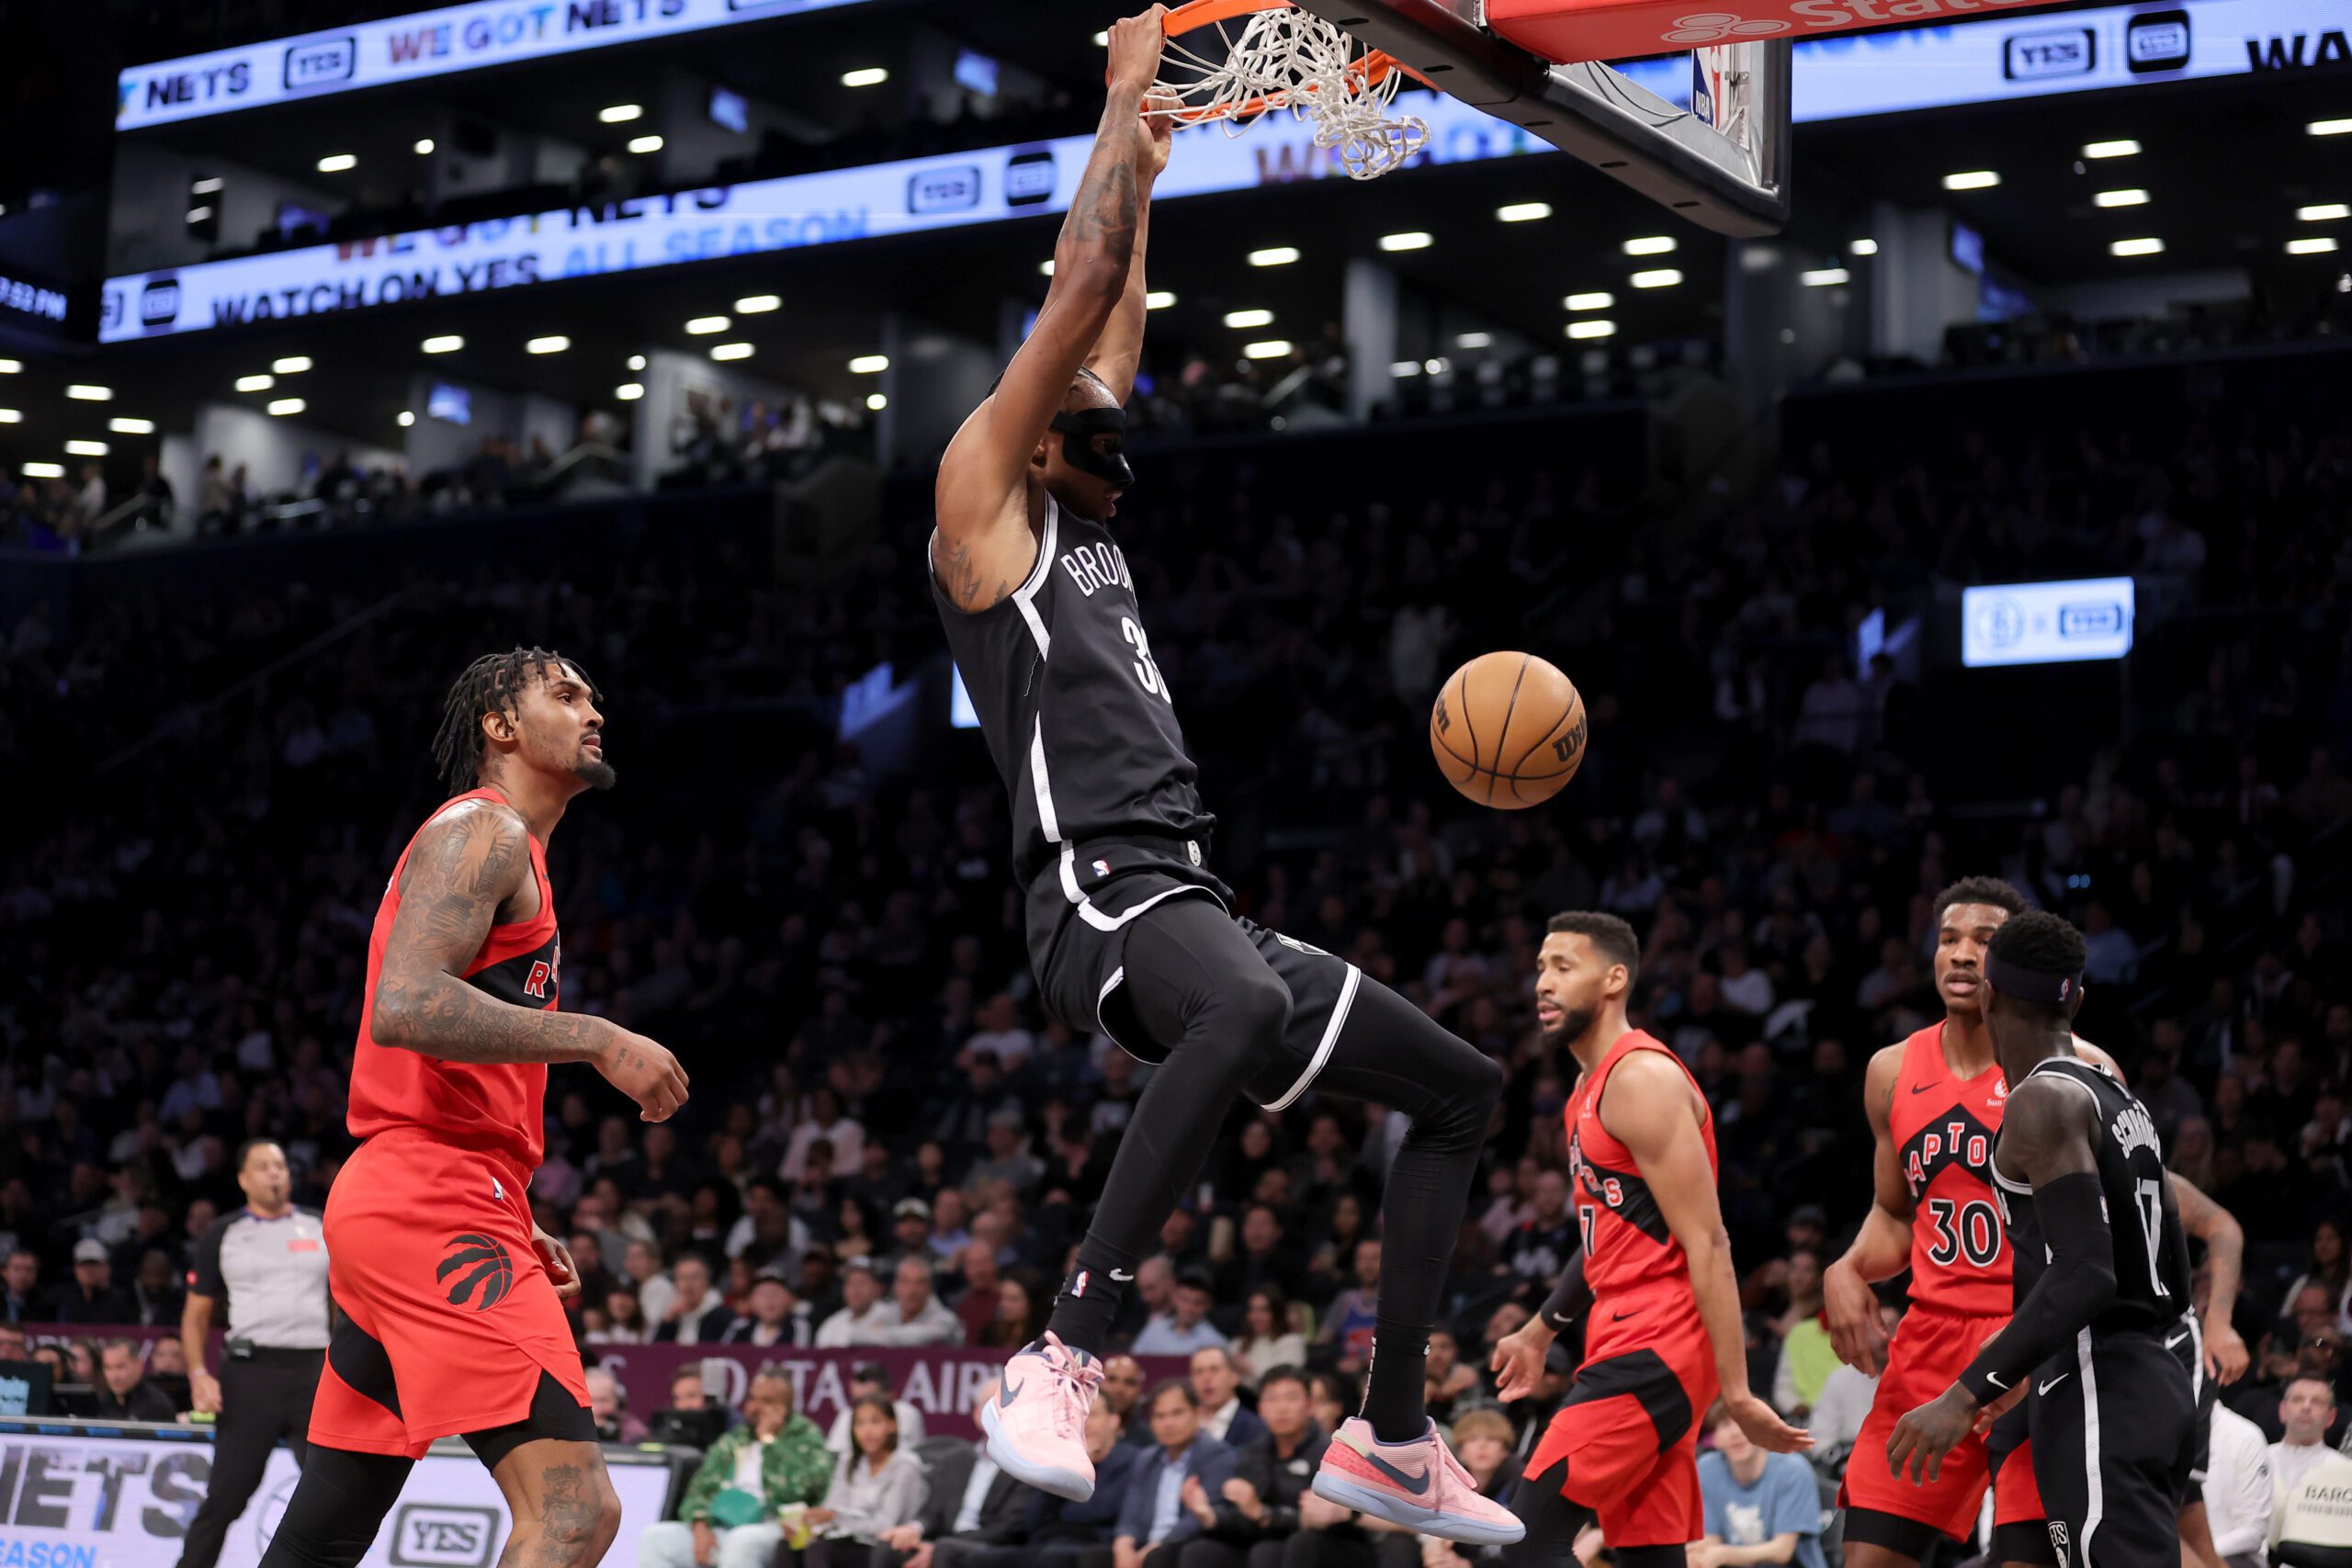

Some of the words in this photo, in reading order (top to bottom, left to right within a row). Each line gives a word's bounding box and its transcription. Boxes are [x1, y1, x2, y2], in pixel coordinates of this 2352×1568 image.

[388, 23, 451, 64] WE
[464, 5, 554, 51] GOT
[1790, 0, 2018, 27] Sta
[2022, 43, 2080, 65] YES
[147, 62, 250, 109] NETS
[1695, 89, 1711, 120] NBA
[212, 282, 366, 323] WATCH
[379, 267, 437, 301] ON
[448, 254, 538, 293] YES
[564, 238, 637, 277] ALL
[664, 209, 868, 262] SEASON
[1060, 541, 1138, 607] BROO
[1579, 1204, 1596, 1259] 7
[1928, 1198, 2001, 1269] 30
[900, 1360, 1005, 1415] AIR
[0, 1540, 96, 1568] ASON
[414, 1520, 479, 1552] YES
[2048, 1524, 2067, 1549] ETS
